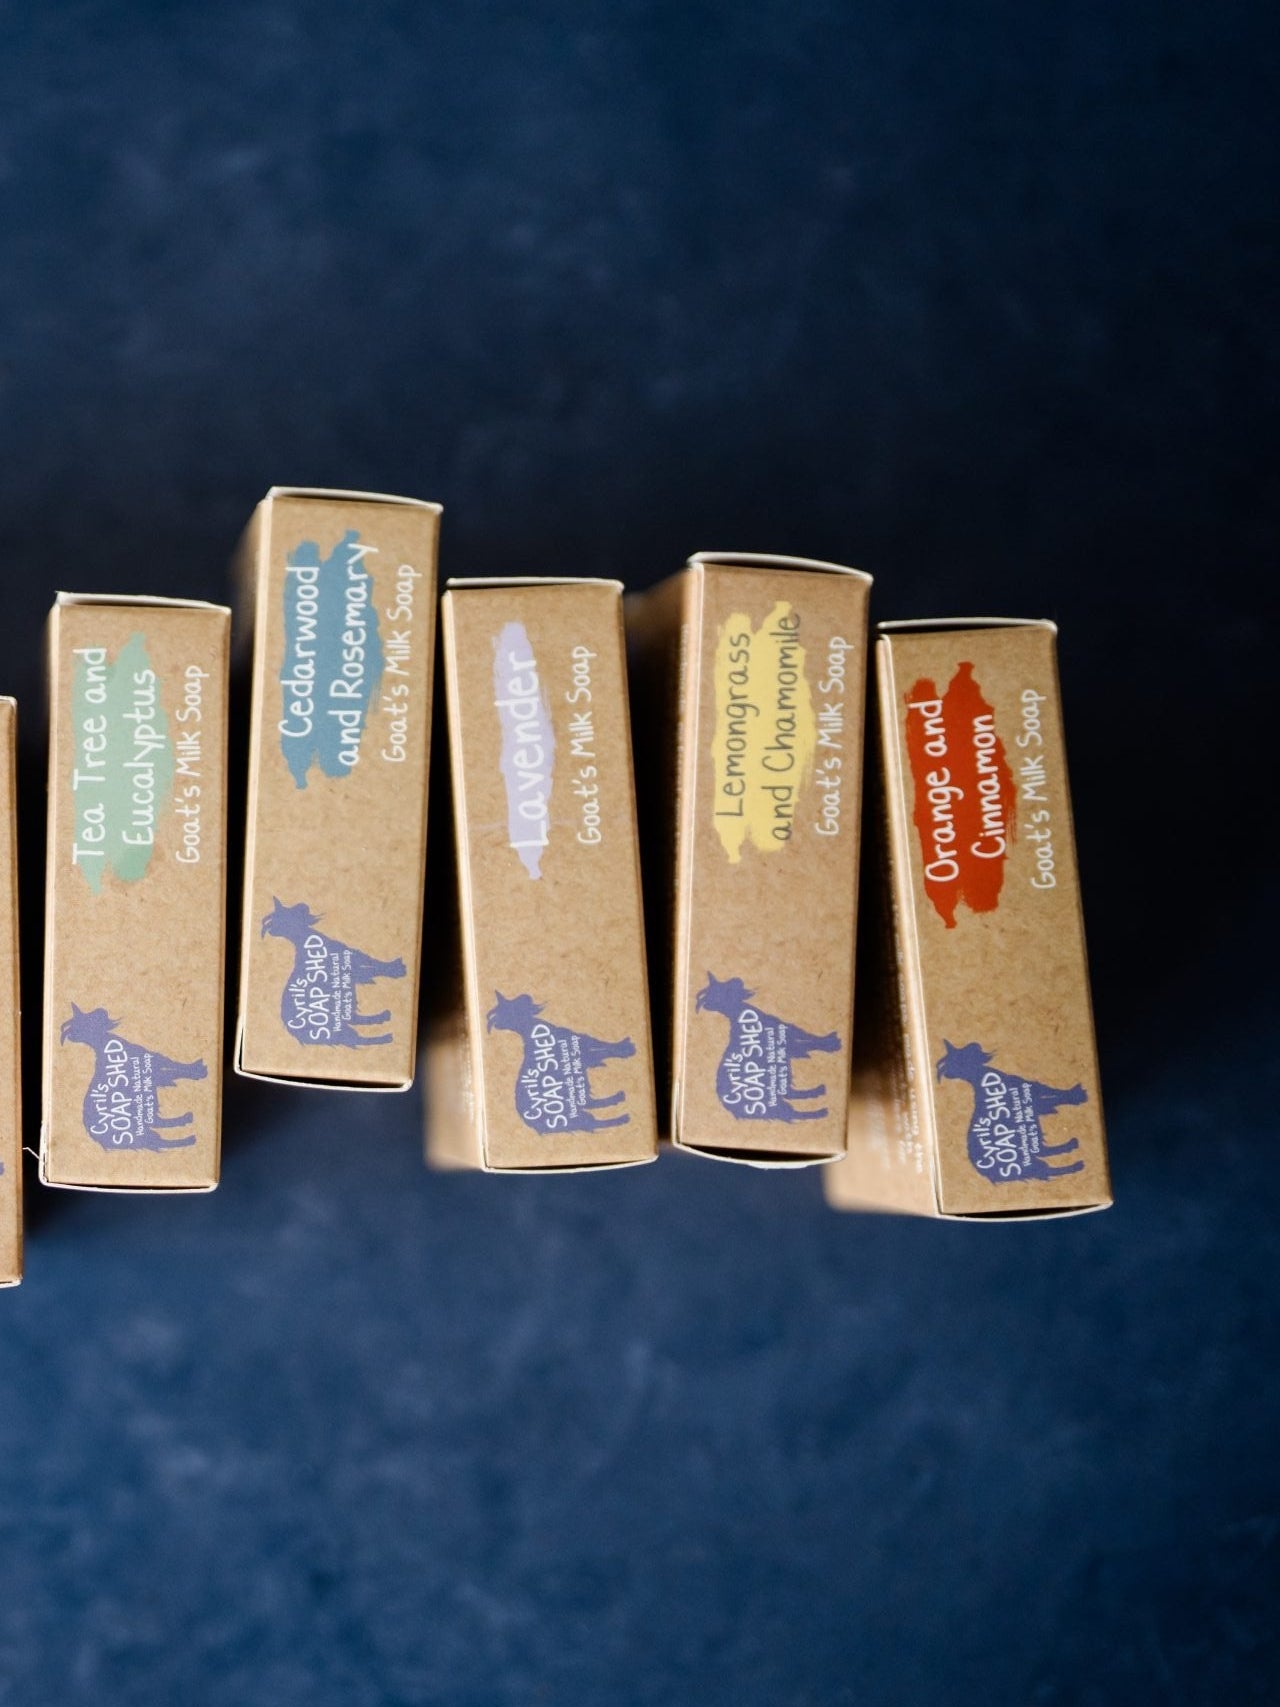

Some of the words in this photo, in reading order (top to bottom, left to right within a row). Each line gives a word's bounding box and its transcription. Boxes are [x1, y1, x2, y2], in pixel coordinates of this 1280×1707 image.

[387, 564, 422, 621] Soap
[330, 543, 379, 698] Rosemary
[72, 648, 106, 704] and
[278, 567, 320, 737] Cedarwood
[385, 630, 411, 676] Milk
[566, 646, 597, 703] Soap
[819, 636, 854, 693] Soap
[176, 665, 210, 722] Soap
[762, 613, 800, 772] Chamomile
[327, 710, 362, 766] and
[382, 684, 409, 762] Goat's
[569, 711, 596, 757] Milk
[715, 633, 760, 817] Lemongrass
[817, 702, 843, 748] Milk
[908, 700, 947, 756] and
[1016, 689, 1046, 747] Soap
[73, 714, 107, 791] Tree
[122, 669, 166, 845] Eucalyptus
[176, 731, 201, 776] Milk
[494, 651, 549, 848] Lavender
[815, 757, 841, 835] Goat's
[971, 714, 1006, 858] Cinnamon
[1020, 755, 1048, 801] Milk
[174, 785, 201, 863] Goat's
[572, 766, 602, 844] Goat's
[761, 786, 794, 840] and
[925, 767, 964, 882] Orange
[72, 803, 105, 864] Tea
[1024, 810, 1056, 889] Goat's
[304, 935, 328, 983] SHED
[330, 953, 340, 988] Natural
[342, 950, 353, 970] Soap
[342, 972, 351, 988] Milk
[288, 978, 313, 1029] Cyril's
[308, 987, 331, 1039] SOAP
[331, 990, 341, 1031] Handmade
[343, 991, 352, 1020] Goat's
[531, 1024, 558, 1072] SHED
[557, 1039, 571, 1075] Natural
[570, 1035, 580, 1055] Soap
[739, 1009, 763, 1057] SHED
[765, 1027, 775, 1062] Natural
[777, 1024, 788, 1044] Soap
[777, 1047, 786, 1063] Milk
[104, 1039, 129, 1087] SHED
[130, 1057, 142, 1092] Natural
[142, 1053, 154, 1073] Soap
[143, 1076, 153, 1092] Milk
[571, 1057, 582, 1074] Milk
[723, 1052, 748, 1104] Cyril's
[766, 1064, 777, 1106] Handmade
[778, 1066, 787, 1094] Goat's
[90, 1083, 115, 1134] Cyril's
[145, 1095, 153, 1123] Goat's
[522, 1068, 548, 1119] Cyril's
[542, 1076, 569, 1128] SOAP
[565, 1076, 578, 1118] Handmade
[575, 1076, 586, 1105] Goat's
[744, 1061, 766, 1114] SOAP
[982, 1072, 1010, 1120] SHED
[1009, 1087, 1024, 1123] Natural
[1022, 1083, 1032, 1103] Soap
[111, 1091, 134, 1144] SOAP
[133, 1094, 144, 1136] Handmade
[1024, 1105, 1035, 1122] Milk
[973, 1117, 1000, 1168] Cyril's
[994, 1124, 1021, 1177] SOAP
[1017, 1124, 1031, 1166] Handmade
[1028, 1124, 1039, 1153] Goat's
